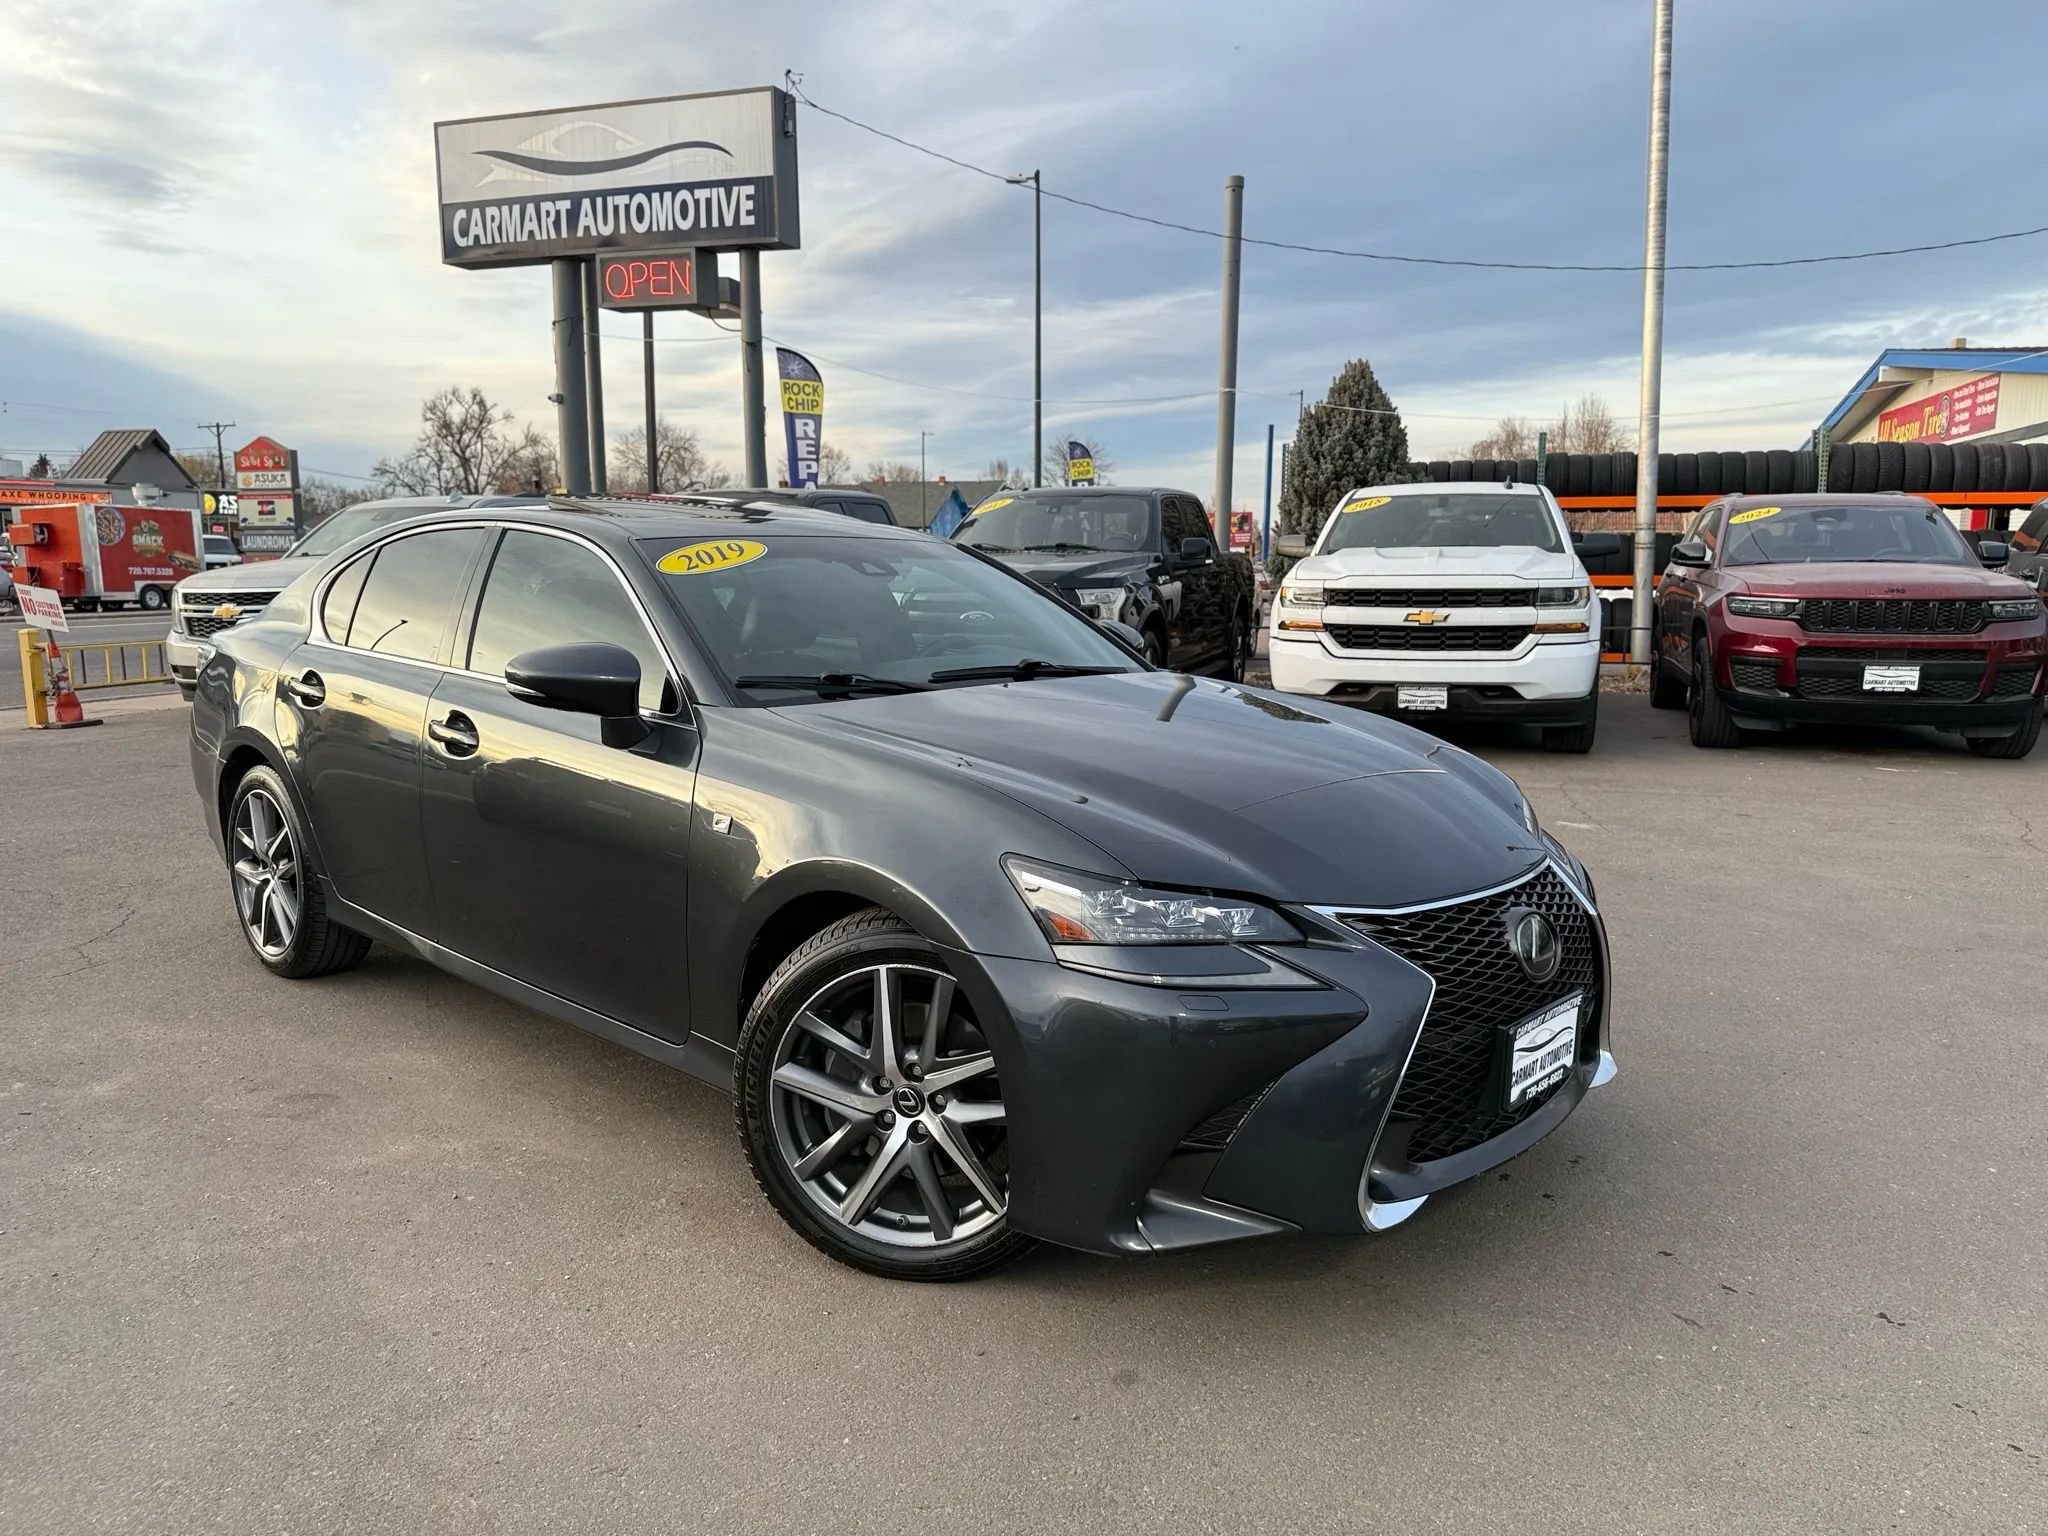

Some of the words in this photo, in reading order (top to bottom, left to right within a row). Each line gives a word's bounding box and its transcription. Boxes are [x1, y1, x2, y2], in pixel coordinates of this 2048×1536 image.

[452, 198, 571, 247] CARMART
[576, 185, 755, 237] AUTOMOTIVE
[605, 260, 691, 298] OPEN
[783, 381, 821, 397] ROCK
[787, 397, 819, 411] CHIP
[1891, 417, 1921, 441] Season
[254, 473, 287, 484] ASUKA
[28, 491, 87, 501] WHOOPING
[132, 534, 164, 546] SMACK
[241, 534, 295, 549] LAUNDROMAT
[677, 542, 745, 571] 2019
[20, 596, 37, 616] NO
[37, 609, 63, 620] PARKING
[1516, 1013, 1545, 1039] CARMART
[1544, 994, 1583, 1022] AUTOMOTIVE
[746, 1013, 775, 1120] MICHELIN
[1511, 1057, 1539, 1088] CARMART
[1539, 1038, 1573, 1072] AUTOMOTIVE
